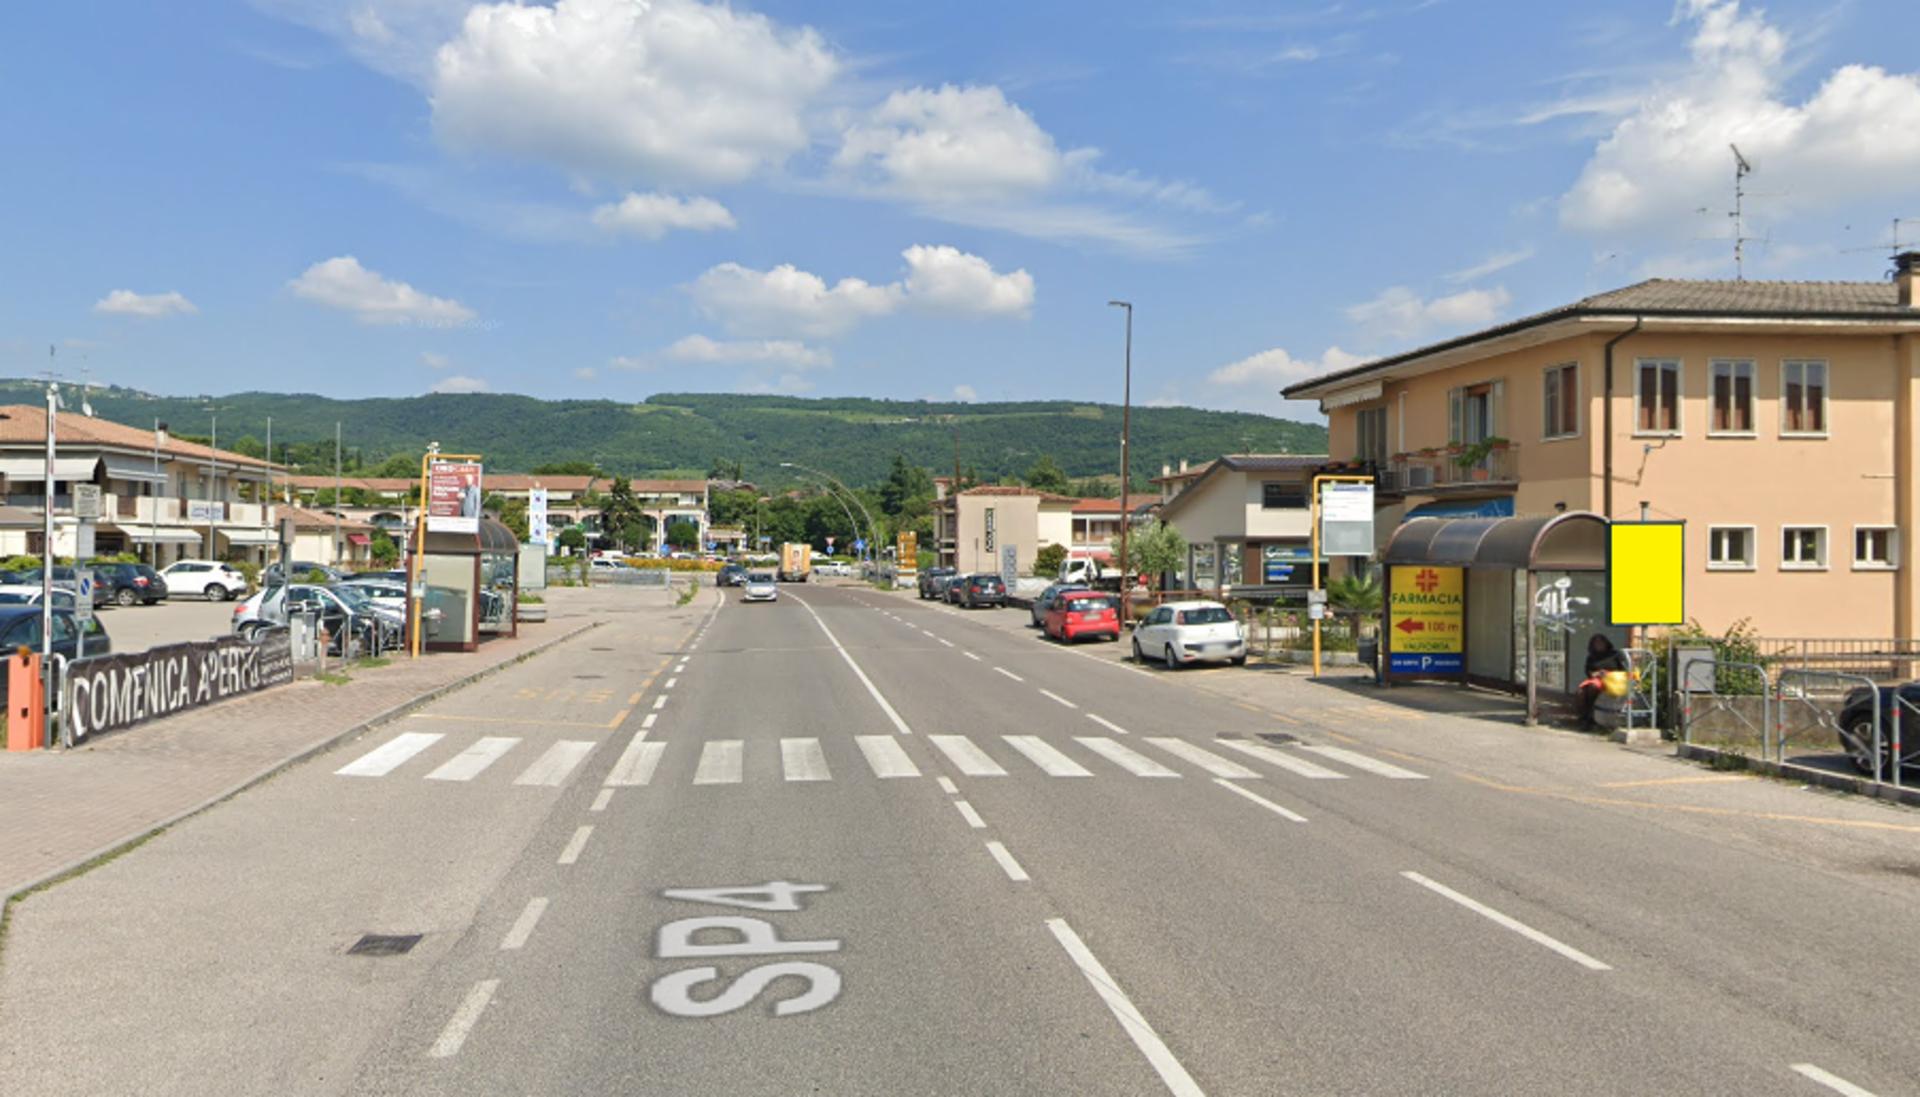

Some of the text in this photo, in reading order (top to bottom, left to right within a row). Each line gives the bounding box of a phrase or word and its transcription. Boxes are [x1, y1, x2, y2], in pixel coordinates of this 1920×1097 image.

[1392, 593, 1461, 605] FARMACIA
[1427, 622, 1459, 632] 100 m
[1421, 656, 1432, 670] P
[72, 655, 191, 737] DOMENICA
